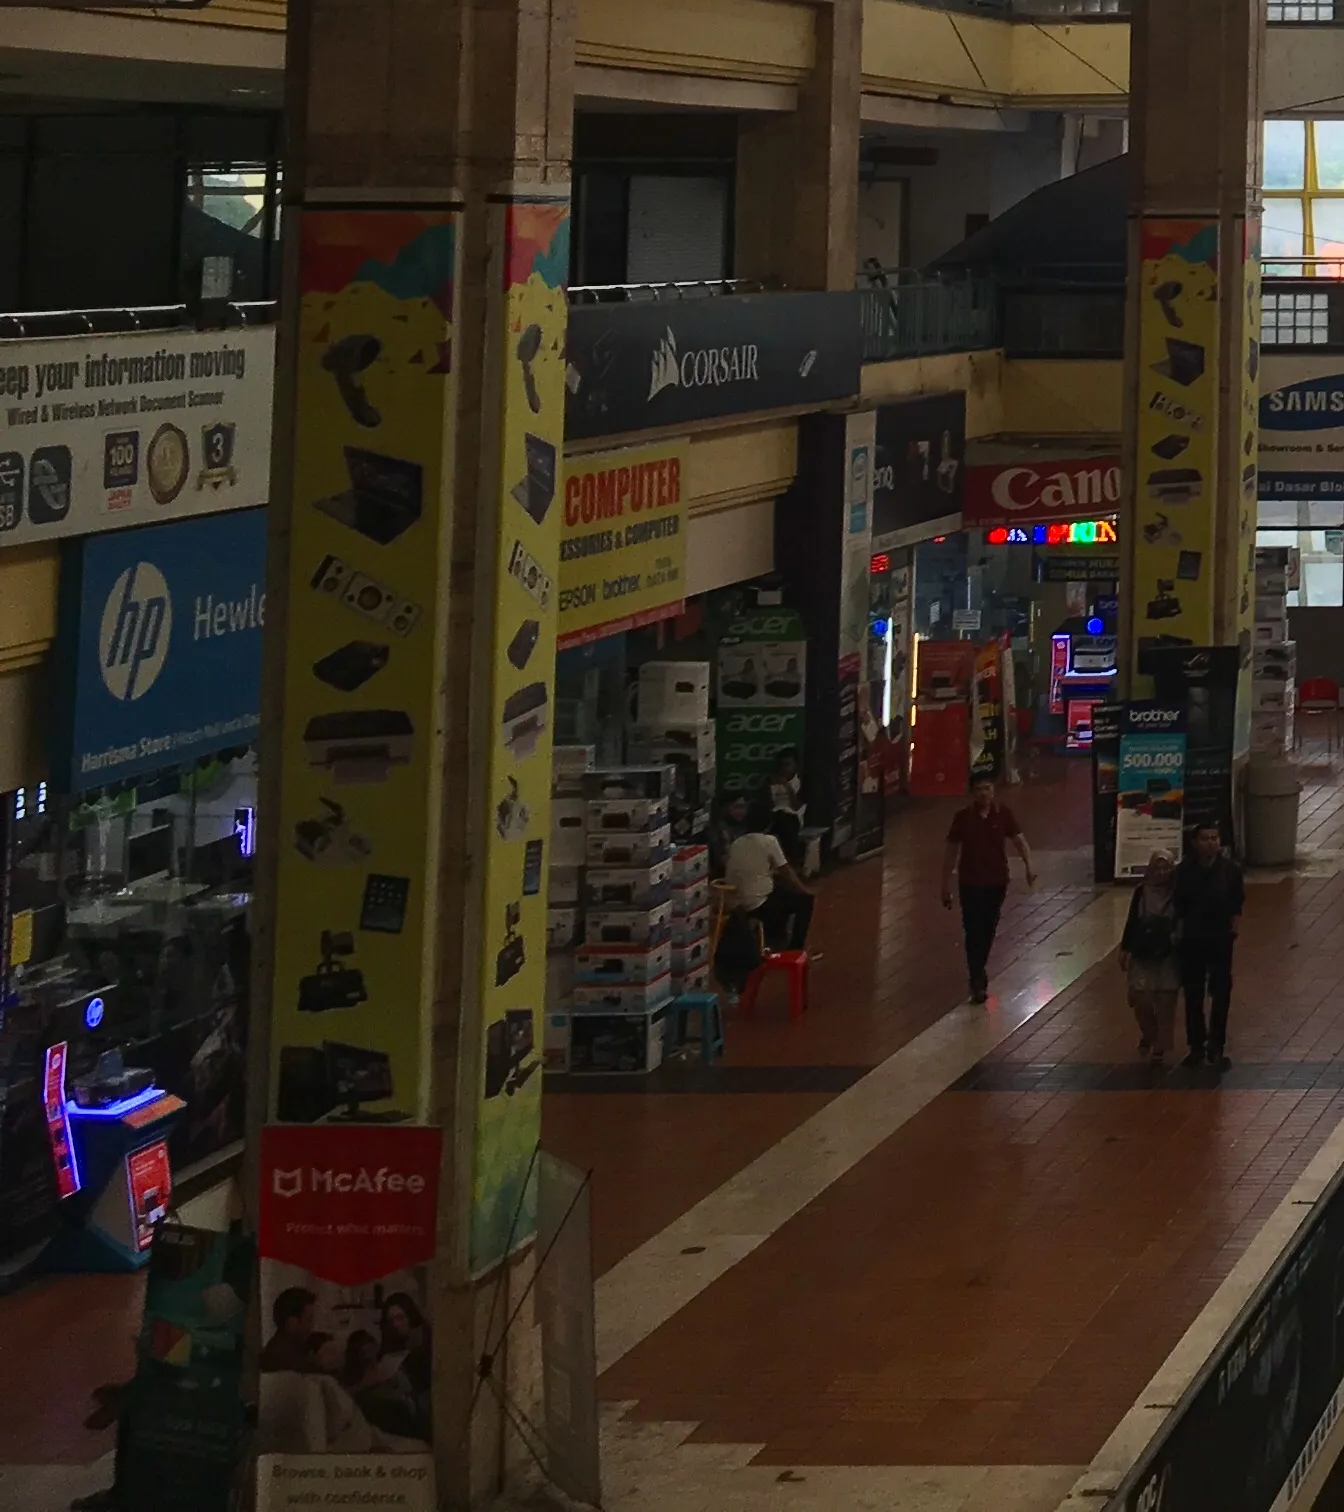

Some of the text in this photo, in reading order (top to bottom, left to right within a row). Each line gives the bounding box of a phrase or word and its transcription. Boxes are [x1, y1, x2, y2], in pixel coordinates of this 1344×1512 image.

[35, 360, 79, 398] your
[85, 349, 185, 388] information
[190, 344, 246, 380] moving
[680, 344, 760, 388] CORSAIR
[8, 406, 37, 427] Wired
[41, 405, 49, 422] &
[52, 401, 95, 421] Wireless
[110, 443, 134, 466] 100
[212, 433, 225, 463] 3
[1257, 443, 1312, 452] Showroom
[564, 457, 681, 527] COMPUTER
[1274, 481, 1316, 493] Dasar
[625, 515, 680, 547] COMPUTER
[559, 583, 596, 612] EPSON
[102, 564, 170, 701] hp
[728, 616, 800, 635] acer
[726, 713, 796, 732] acer
[1129, 708, 1181, 722] brother
[1123, 752, 1184, 768] 500.000
[311, 1166, 427, 1194] McAfee
[334, 1465, 372, 1479] bank
[375, 1466, 387, 1478] &
[389, 1466, 427, 1482] shop
[286, 1490, 407, 1504] with confidence
